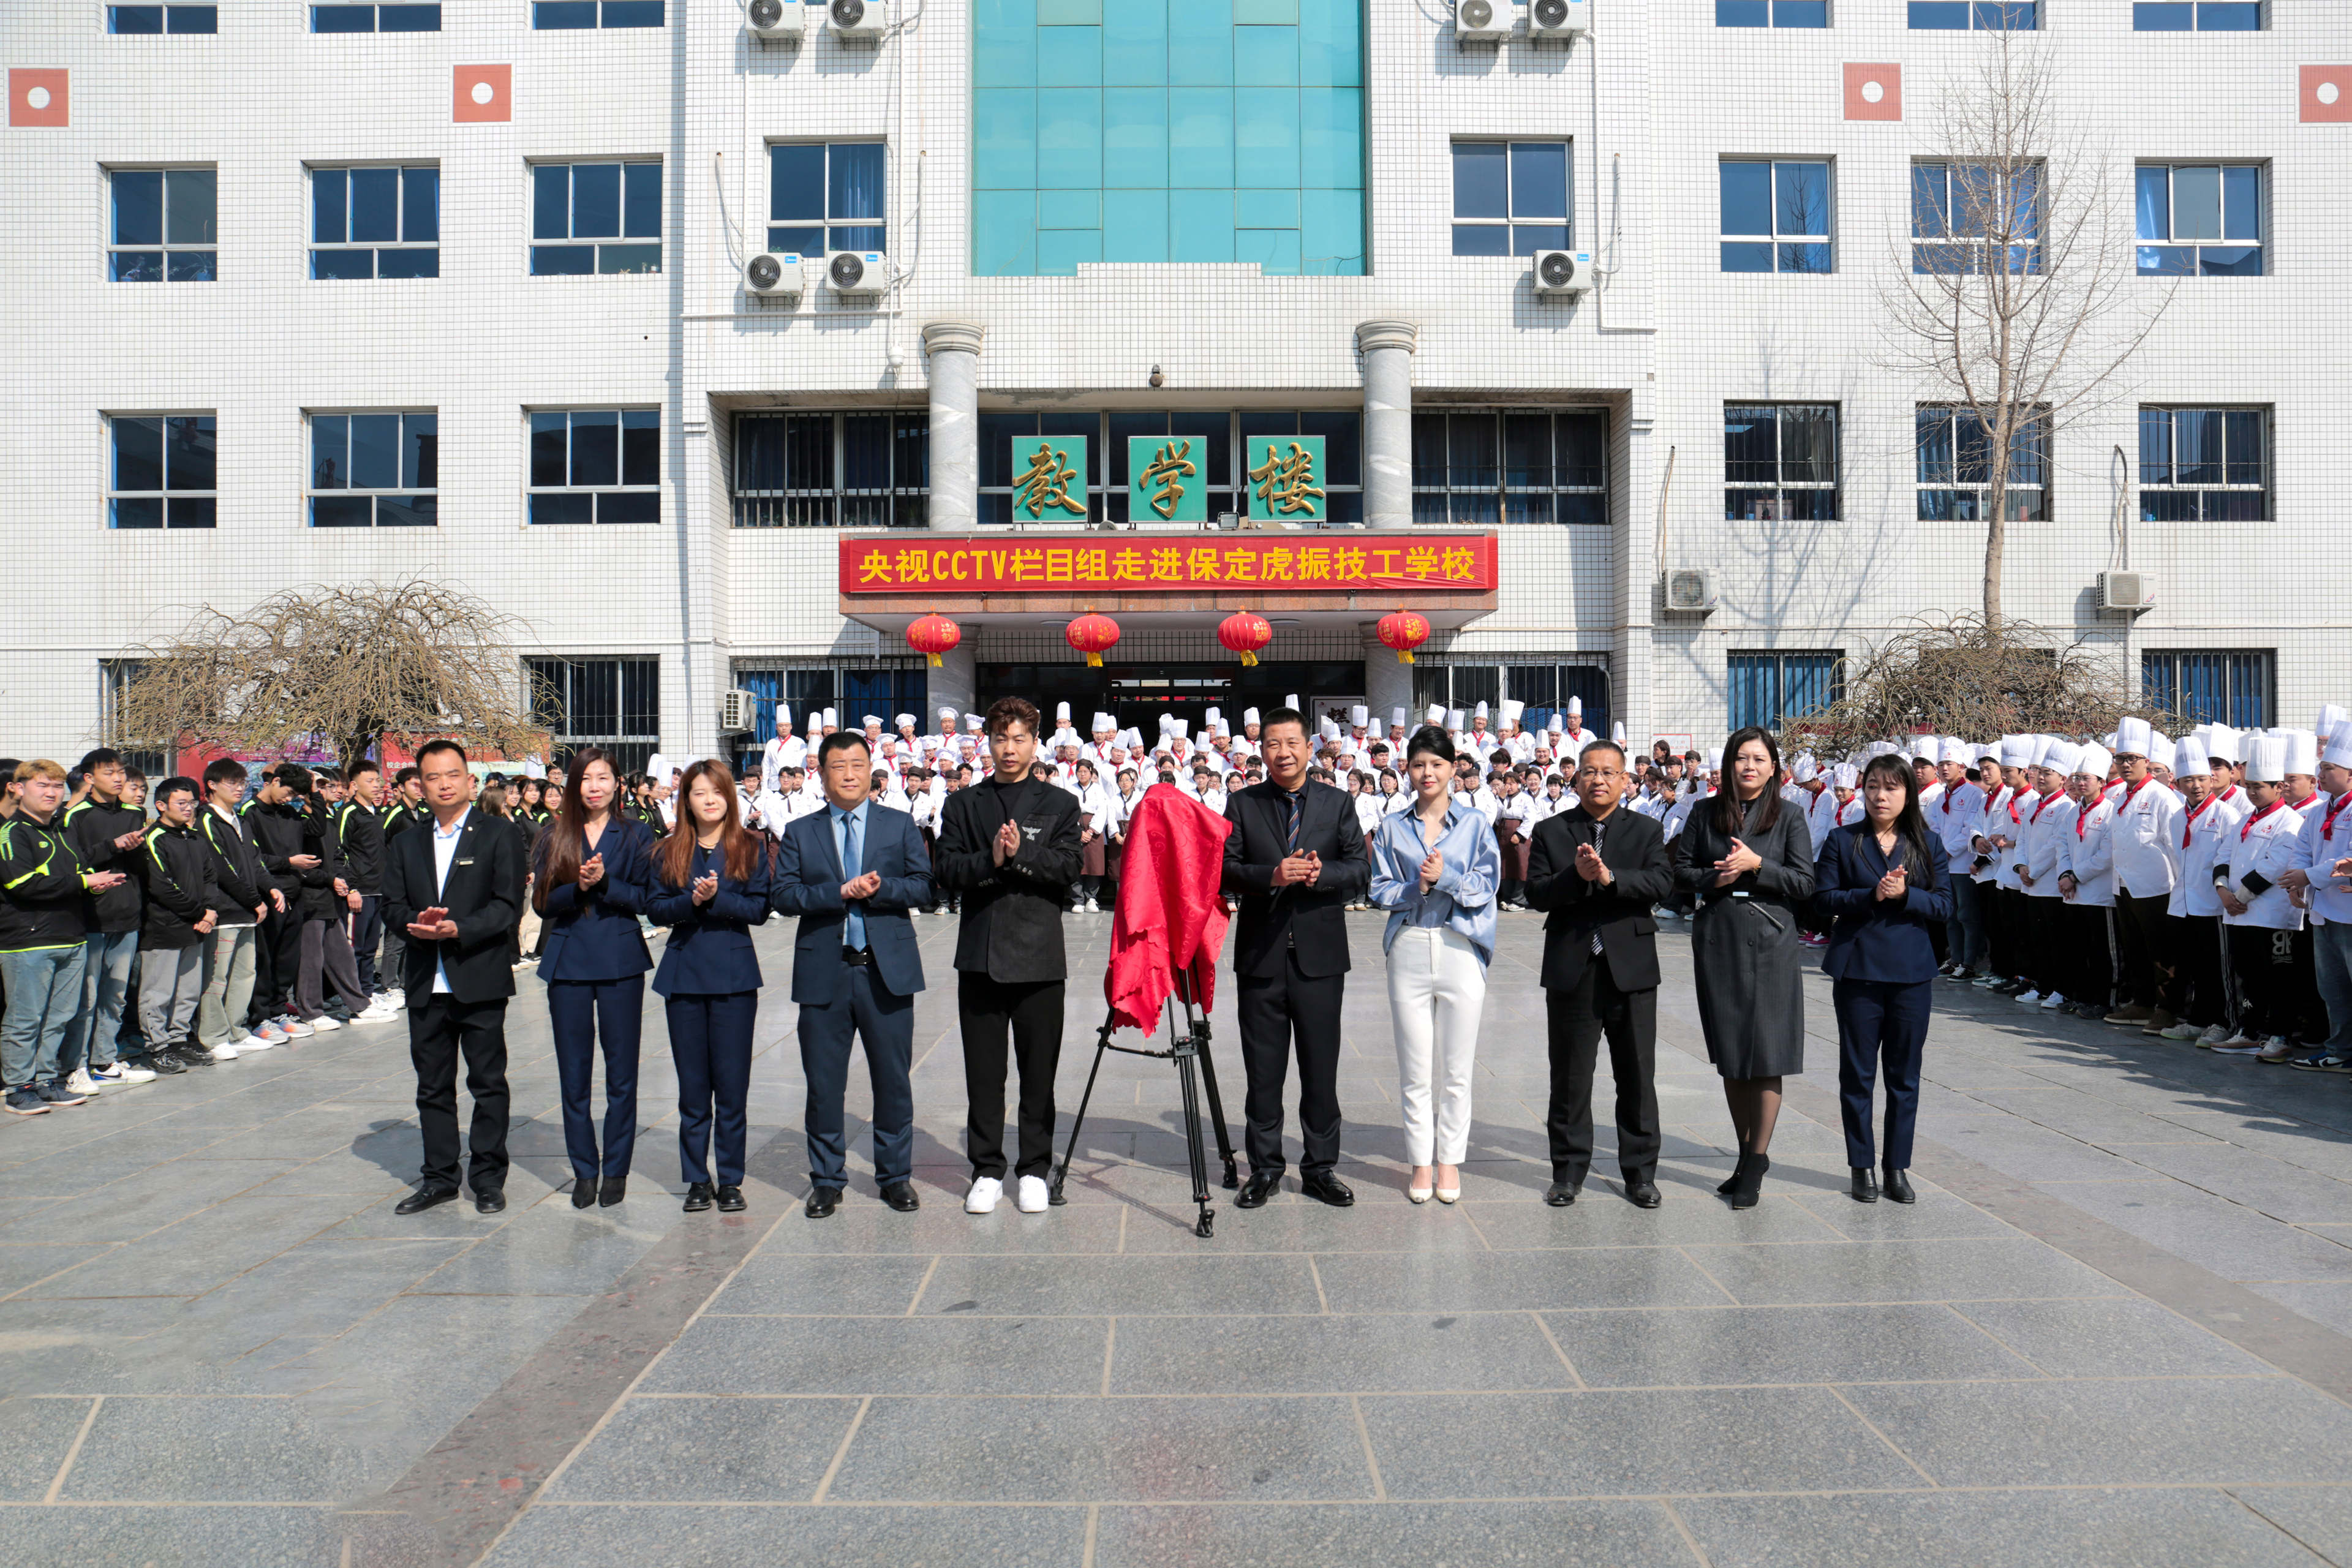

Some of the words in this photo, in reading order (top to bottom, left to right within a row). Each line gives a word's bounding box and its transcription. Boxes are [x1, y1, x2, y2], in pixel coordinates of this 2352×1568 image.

[1012, 440, 1325, 519] 教学楼
[859, 546, 1475, 582] 央视CCTV栏目组走进保定虎振技工学校
